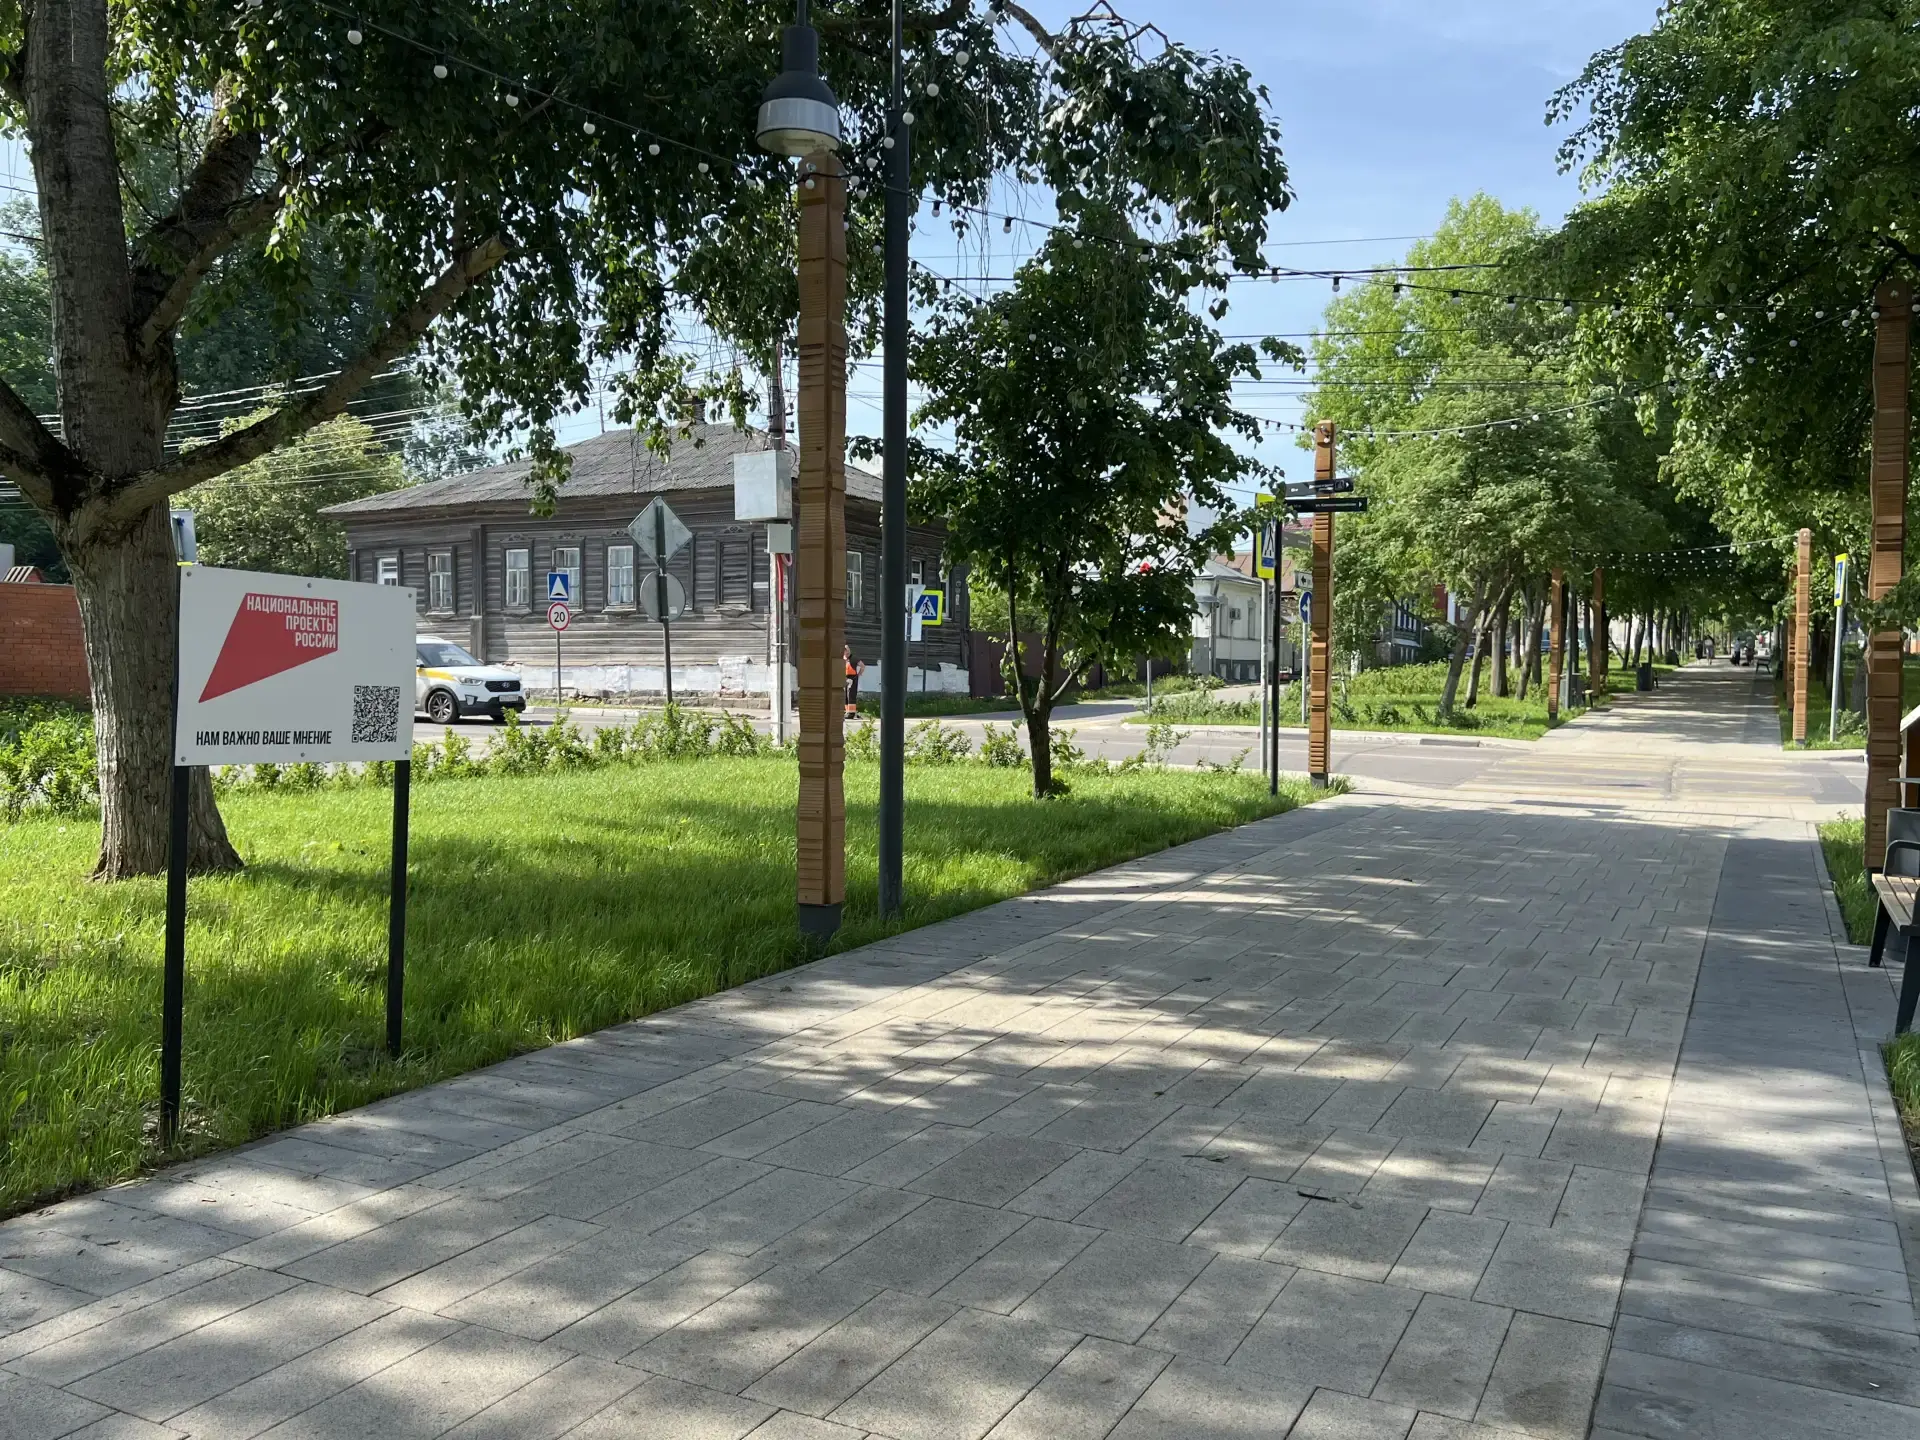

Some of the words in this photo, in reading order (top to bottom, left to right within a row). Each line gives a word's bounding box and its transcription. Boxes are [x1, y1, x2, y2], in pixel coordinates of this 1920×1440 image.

[247, 596, 336, 616] НАЦИОНАЛЬНЫЕ
[286, 615, 336, 632] ПРОЕКТЫ
[554, 611, 565, 622] 20
[295, 632, 336, 648] РОССИИ
[196, 730, 220, 746] НАМ
[222, 730, 260, 746] ВАЖНО
[262, 730, 291, 745] ВАШЕ
[292, 730, 332, 745] МНЕНИЕ
